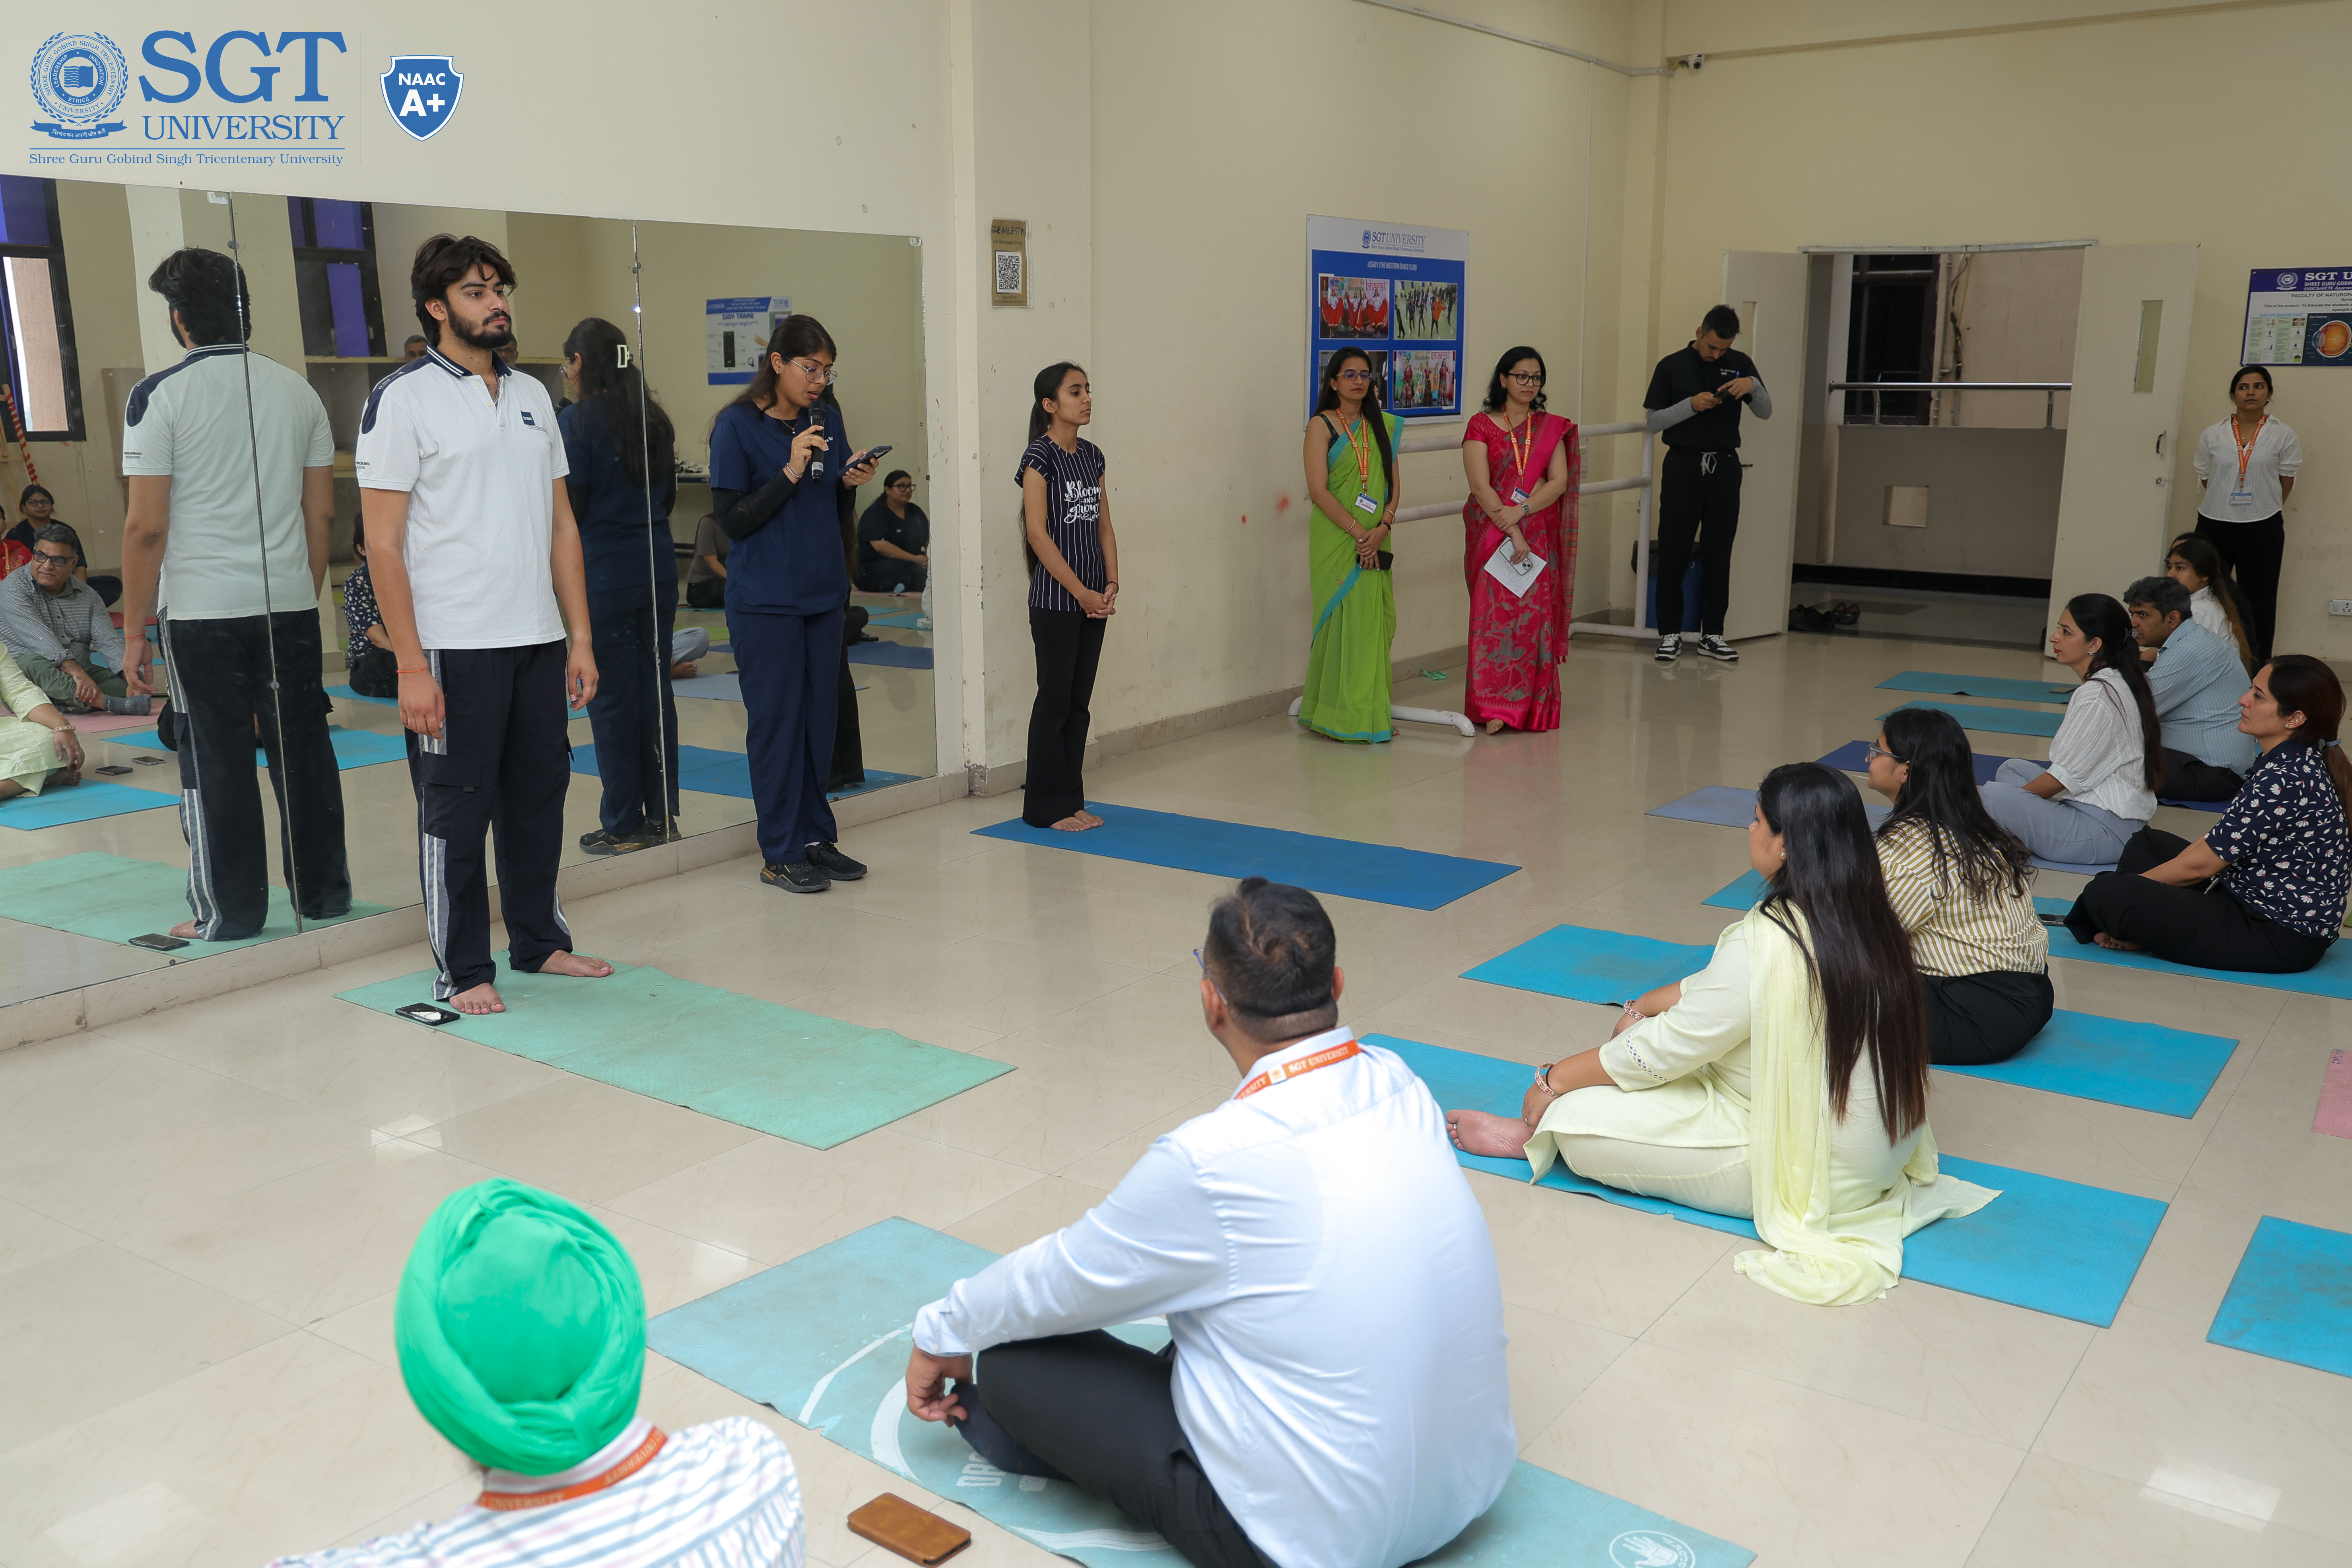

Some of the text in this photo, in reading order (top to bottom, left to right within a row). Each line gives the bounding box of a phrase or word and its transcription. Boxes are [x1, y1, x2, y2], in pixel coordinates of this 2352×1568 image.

[1002, 227, 1024, 235] MAJESTY
[1372, 231, 1426, 245] SGT UNIVERSITY
[2305, 272, 2338, 281] SGT
[1064, 480, 1101, 502] Bloom
[1064, 503, 1099, 523] grow
[1288, 1046, 1348, 1073] SGT UNIVERSITY
